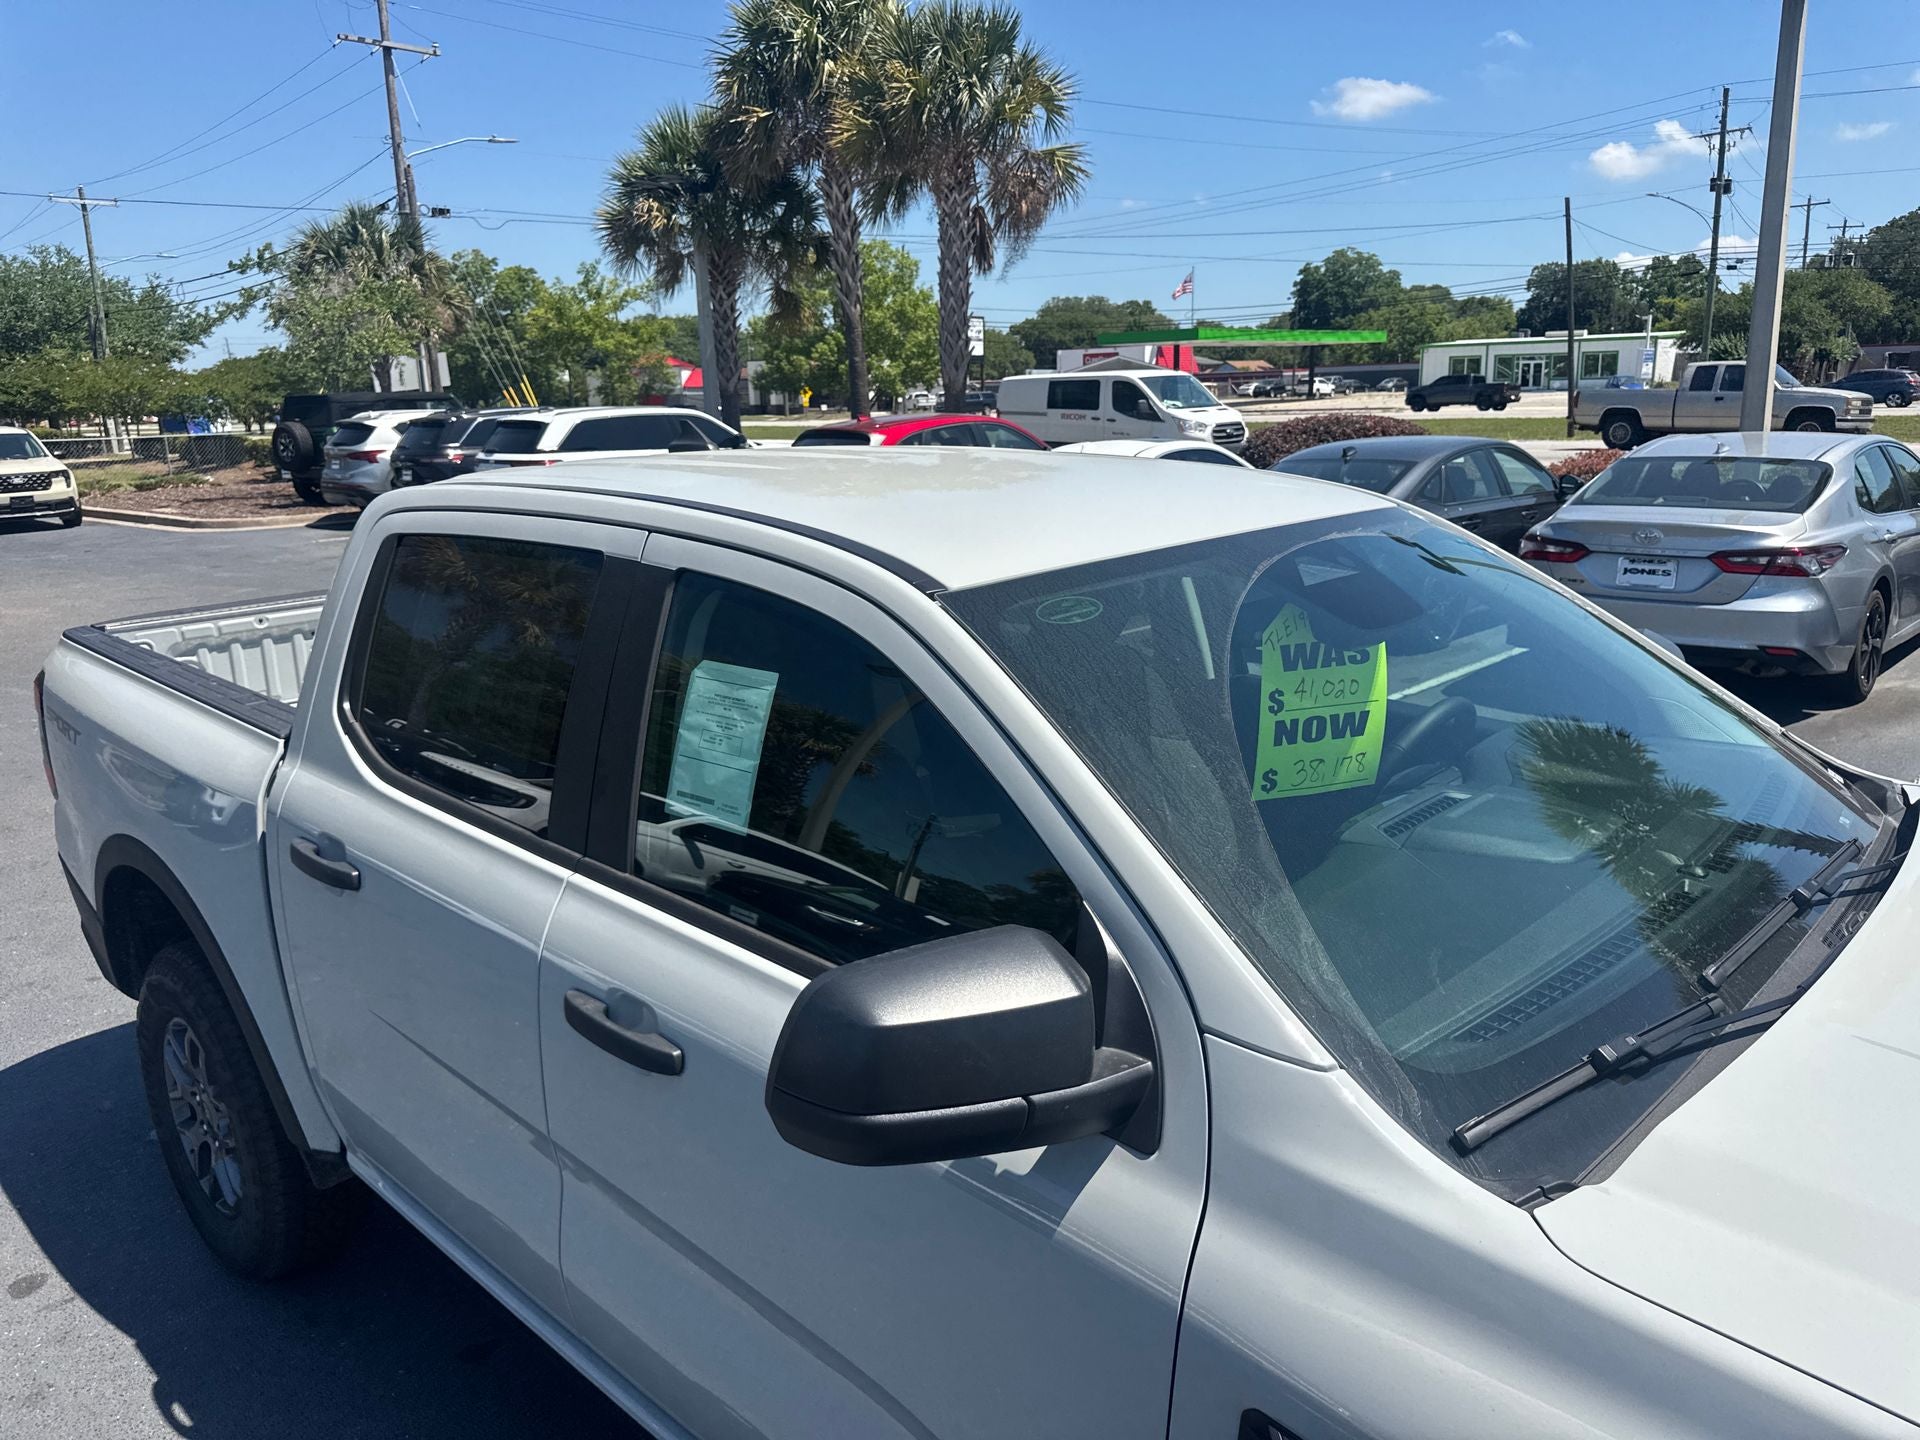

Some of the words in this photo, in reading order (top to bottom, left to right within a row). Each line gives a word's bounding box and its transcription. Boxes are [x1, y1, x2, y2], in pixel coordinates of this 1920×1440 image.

[1060, 412, 1087, 421] RICOH
[1622, 567, 1672, 577] JONES
[1279, 642, 1371, 672] WAS
[1267, 688, 1285, 716] $
[1294, 677, 1360, 704] 41,020
[1273, 710, 1371, 747] NOW
[1260, 768, 1278, 794] $
[1291, 752, 1367, 787] 38,178
